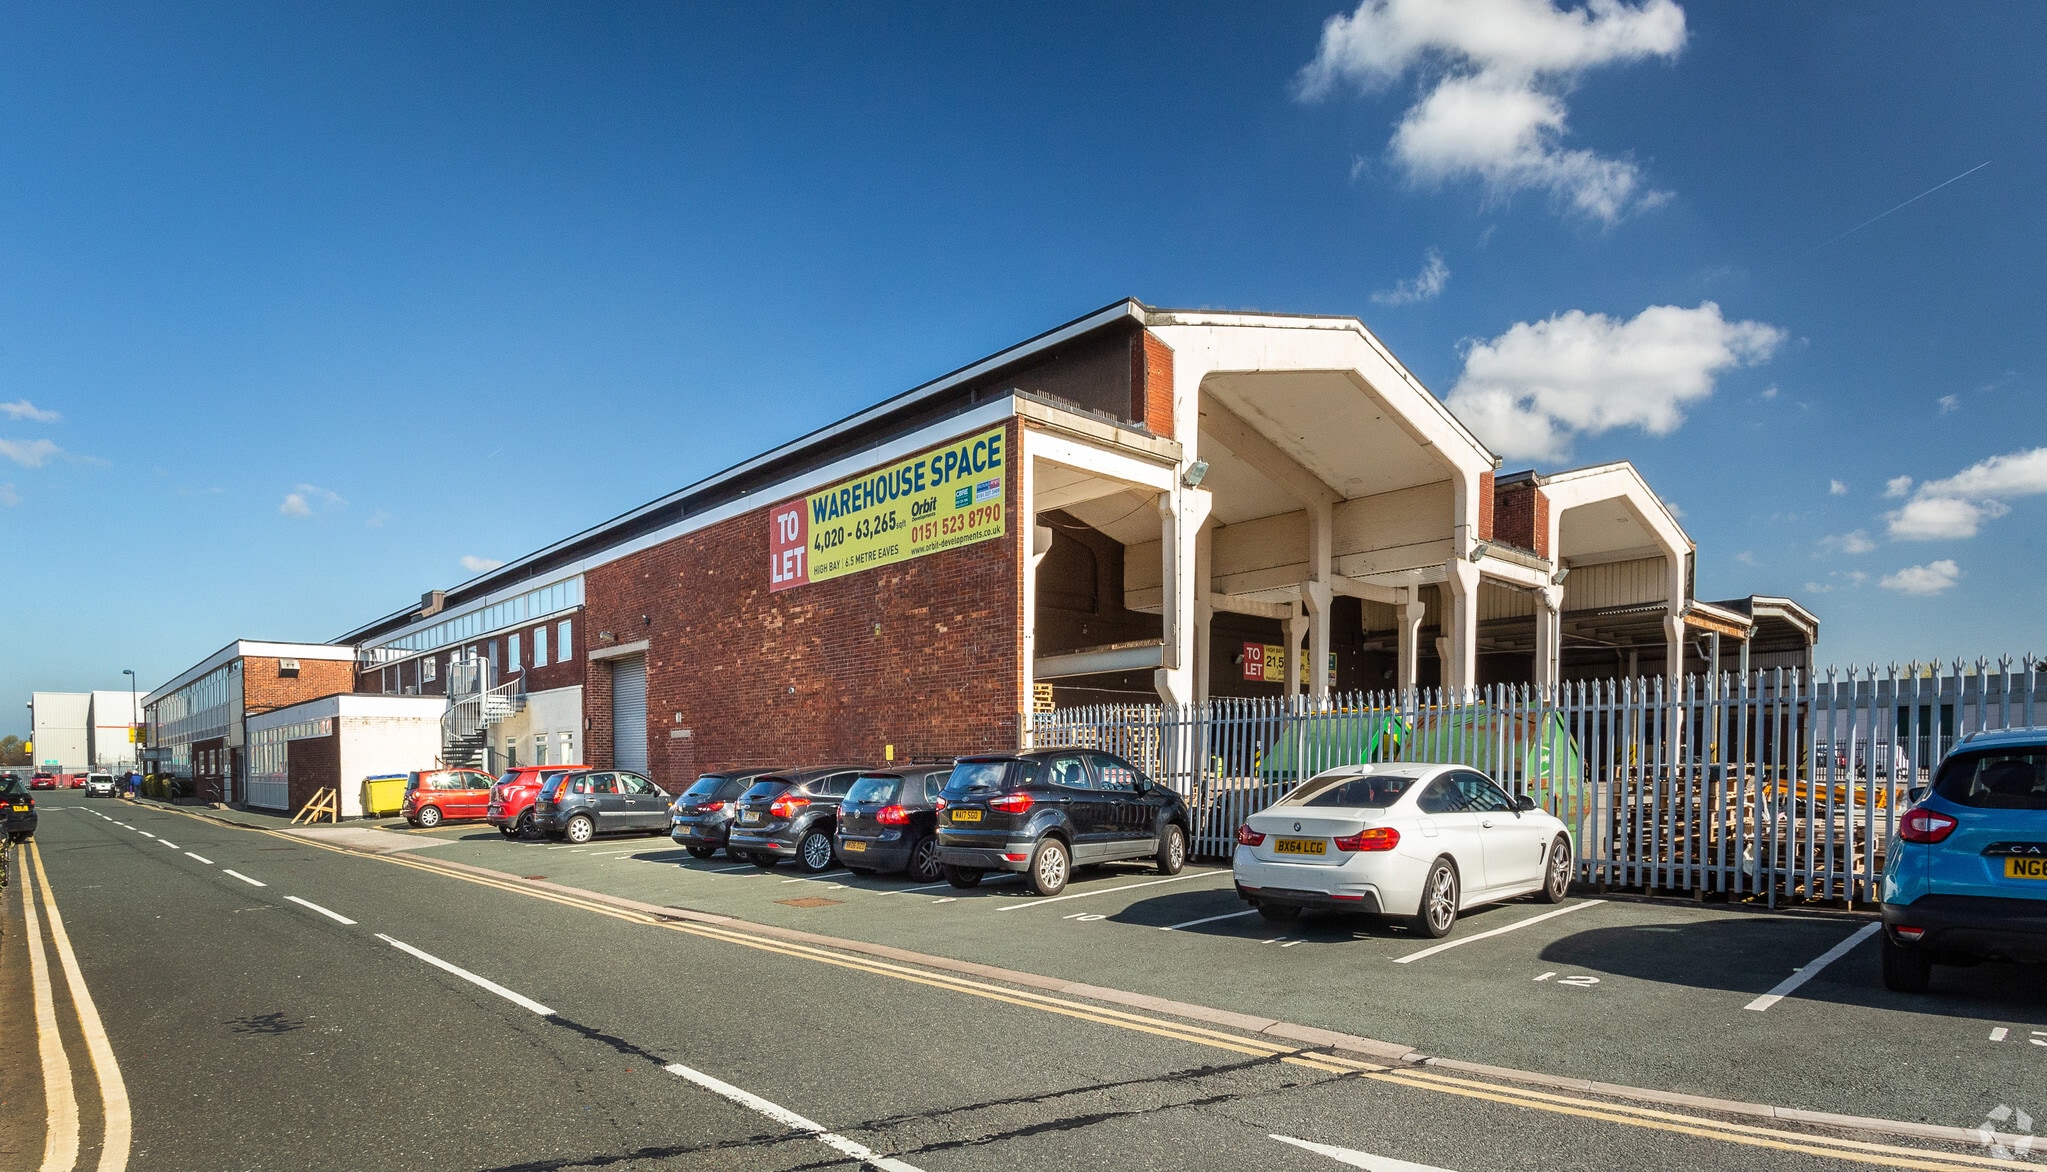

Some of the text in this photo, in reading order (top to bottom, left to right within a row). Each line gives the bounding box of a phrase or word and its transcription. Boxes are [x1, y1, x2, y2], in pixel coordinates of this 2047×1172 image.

[812, 434, 1002, 524] WAREHOUSE SPACE
[911, 496, 937, 517] Orbit
[777, 510, 799, 545] TO
[911, 503, 1000, 543] 0151 523 8790
[814, 526, 844, 554] 4,020
[911, 525, 1001, 555] www.orbit-developments.co.uk
[772, 546, 805, 584] LET
[813, 544, 899, 575] HIGH BAY 6.5 METRE EAVES
[1246, 647, 1260, 660] TO
[1266, 655, 1284, 669] 21,5
[1245, 663, 1263, 676] LET
[1278, 840, 1323, 854] BX64 LCG
[2010, 846, 2041, 854] CA
[1532, 971, 1600, 987] 12
